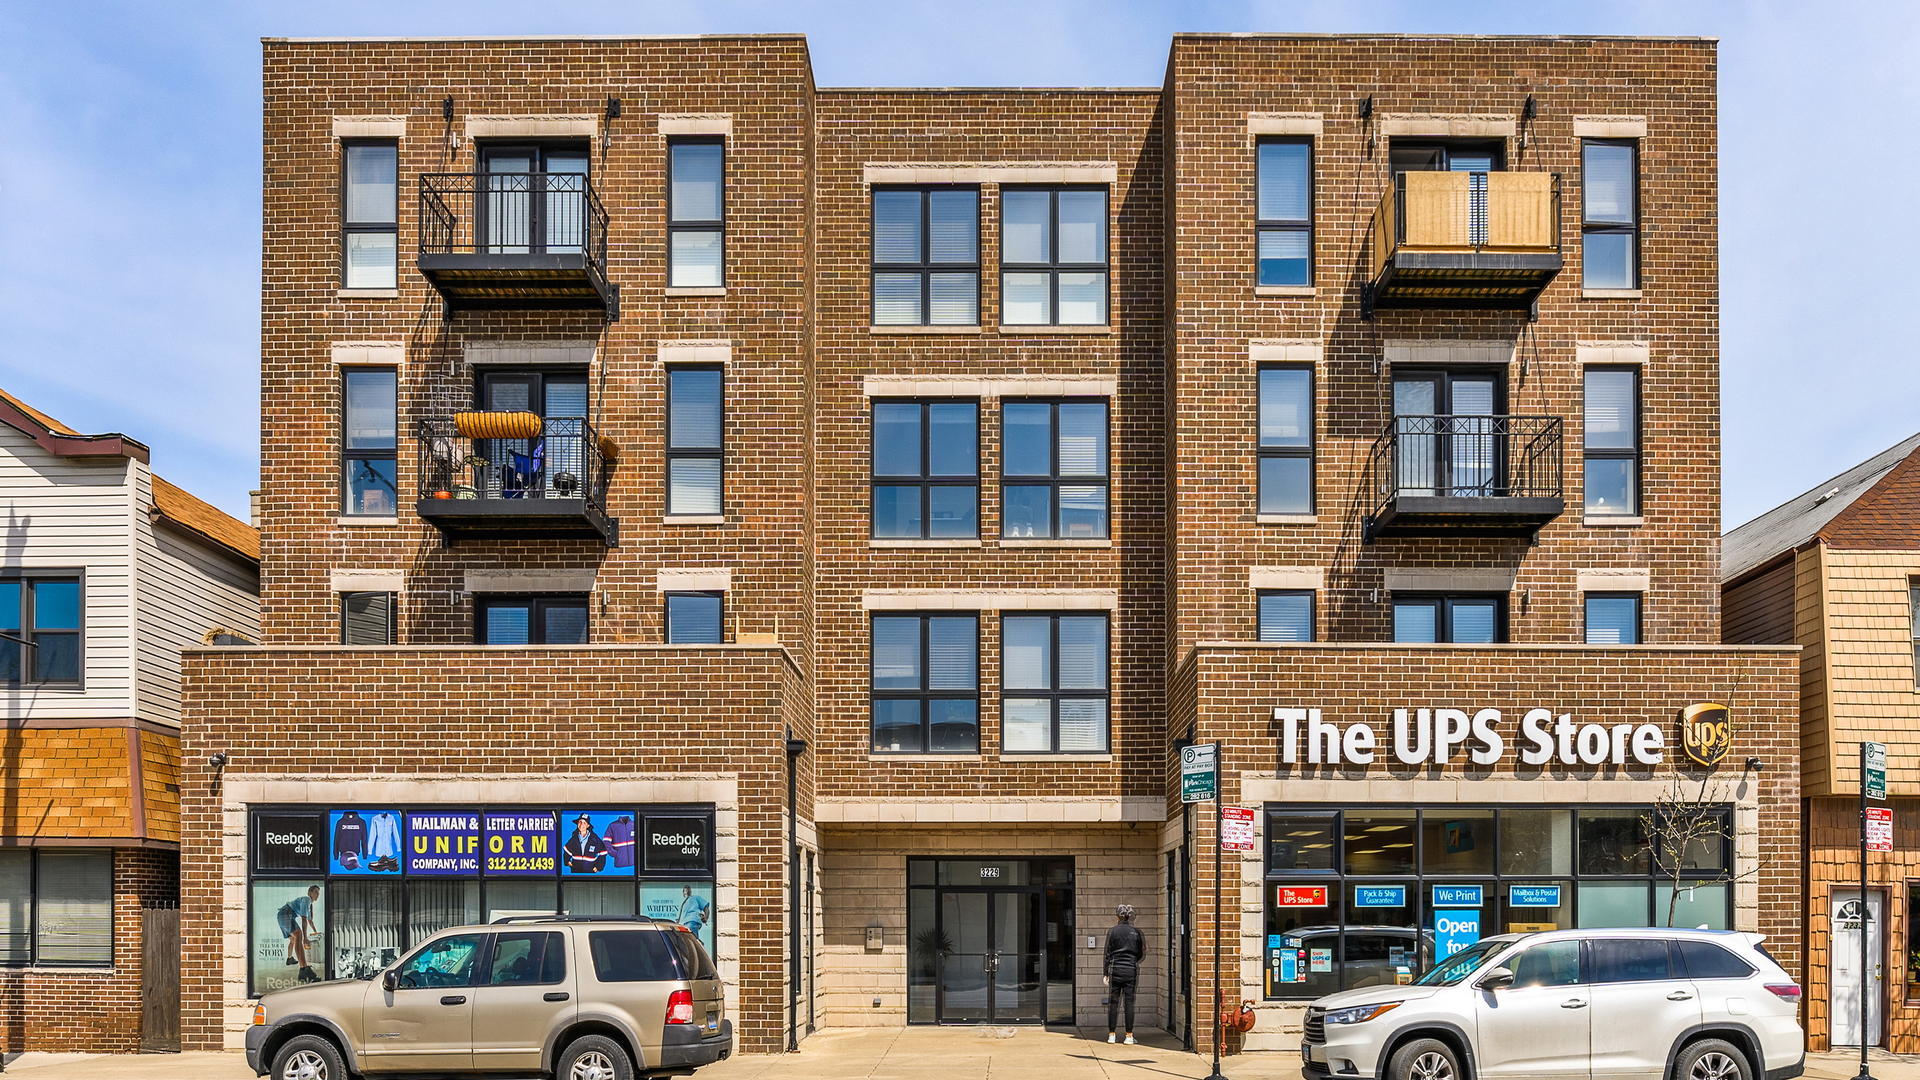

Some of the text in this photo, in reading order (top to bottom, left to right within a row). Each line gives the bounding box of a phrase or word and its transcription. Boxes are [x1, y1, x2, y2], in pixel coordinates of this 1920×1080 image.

[1274, 707, 1665, 766] The UPS Store
[412, 817, 554, 830] MAILMAN & LETTER CARRIER
[266, 832, 313, 845] Reebok
[652, 833, 700, 846] Reebok
[294, 845, 313, 855] duty
[681, 846, 700, 857] duty
[412, 857, 555, 871] COMPANY, INC. 312 212-1439
[981, 868, 1000, 878] 3229
[1384, 890, 1397, 899] Ship
[1439, 890, 1476, 901] We Print
[1437, 918, 1478, 936] Open
[1843, 921, 1861, 930] 323
[259, 949, 285, 957] STORY
[266, 976, 312, 990] Reeb
